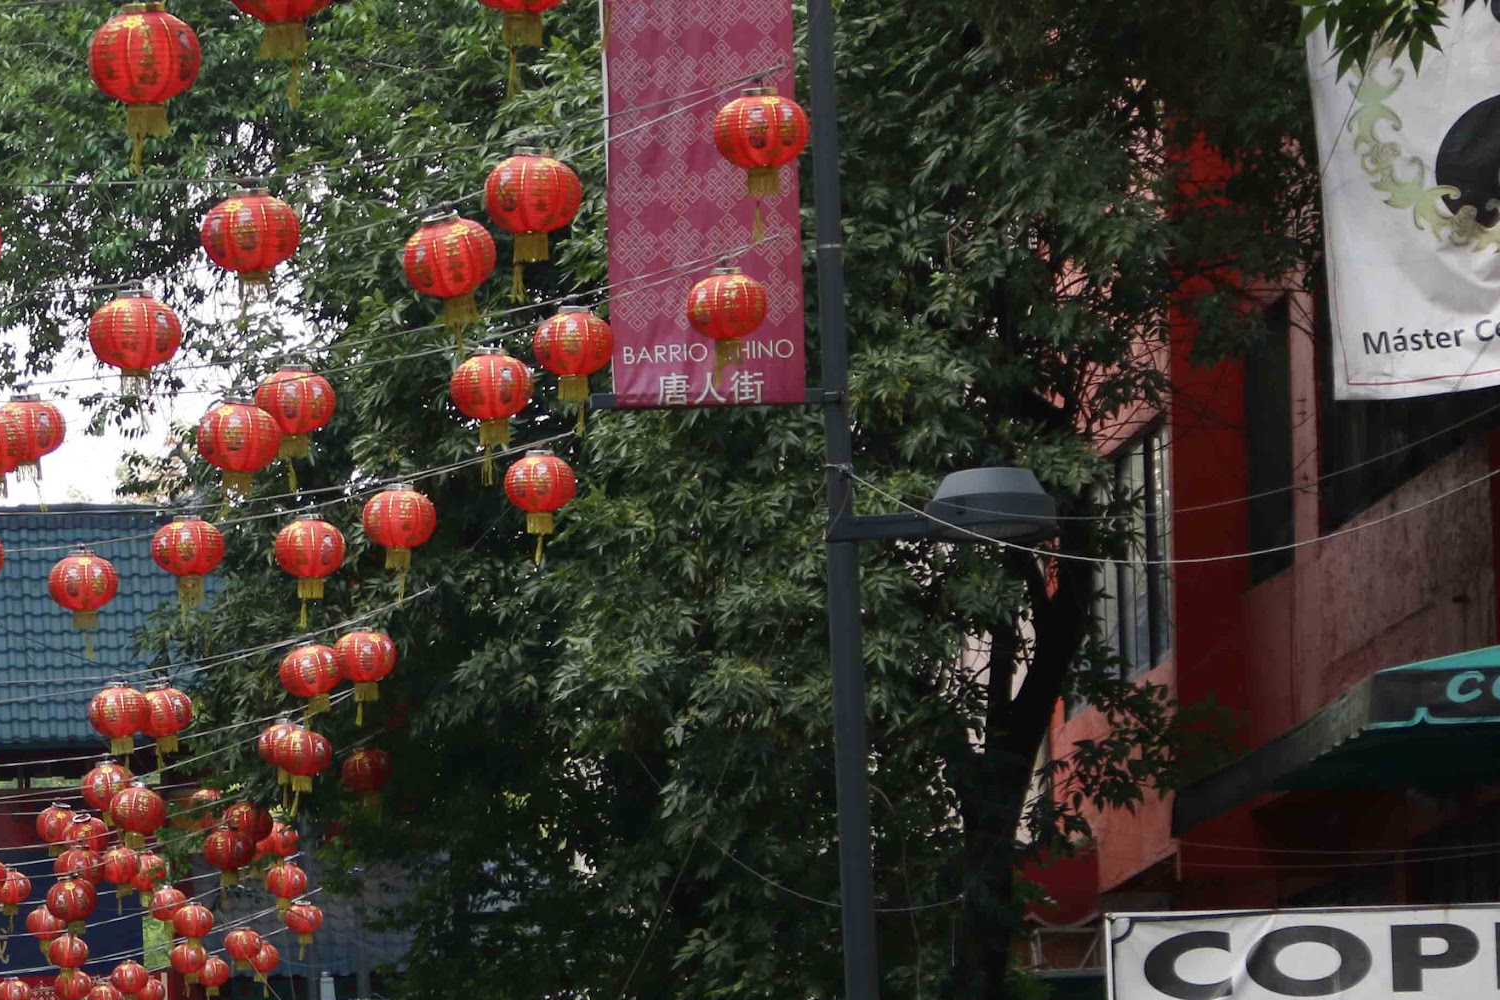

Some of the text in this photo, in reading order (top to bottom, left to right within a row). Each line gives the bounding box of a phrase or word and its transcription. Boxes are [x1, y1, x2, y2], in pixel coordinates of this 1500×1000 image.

[622, 339, 794, 365] BARRIO HINO
[1362, 327, 1465, 355] Máster
[657, 370, 764, 406] 唐人街
[1446, 670, 1500, 703] C
[1144, 924, 1500, 1000] COP
